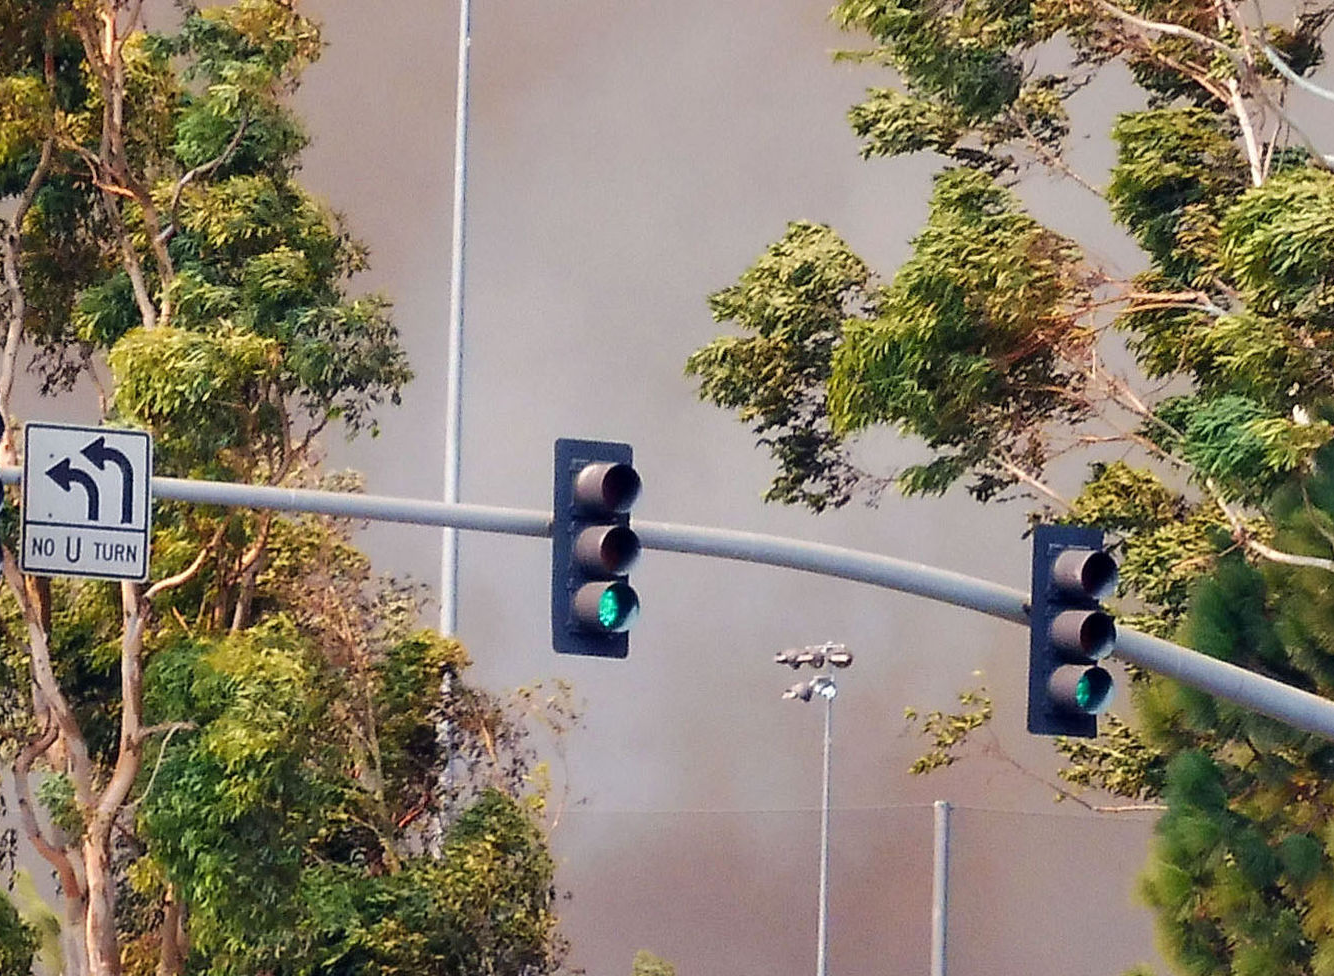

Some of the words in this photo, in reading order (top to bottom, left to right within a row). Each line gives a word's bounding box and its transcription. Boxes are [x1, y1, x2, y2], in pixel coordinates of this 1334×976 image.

[31, 537, 55, 557] NO
[66, 536, 81, 563] U
[94, 541, 137, 563] TURN
